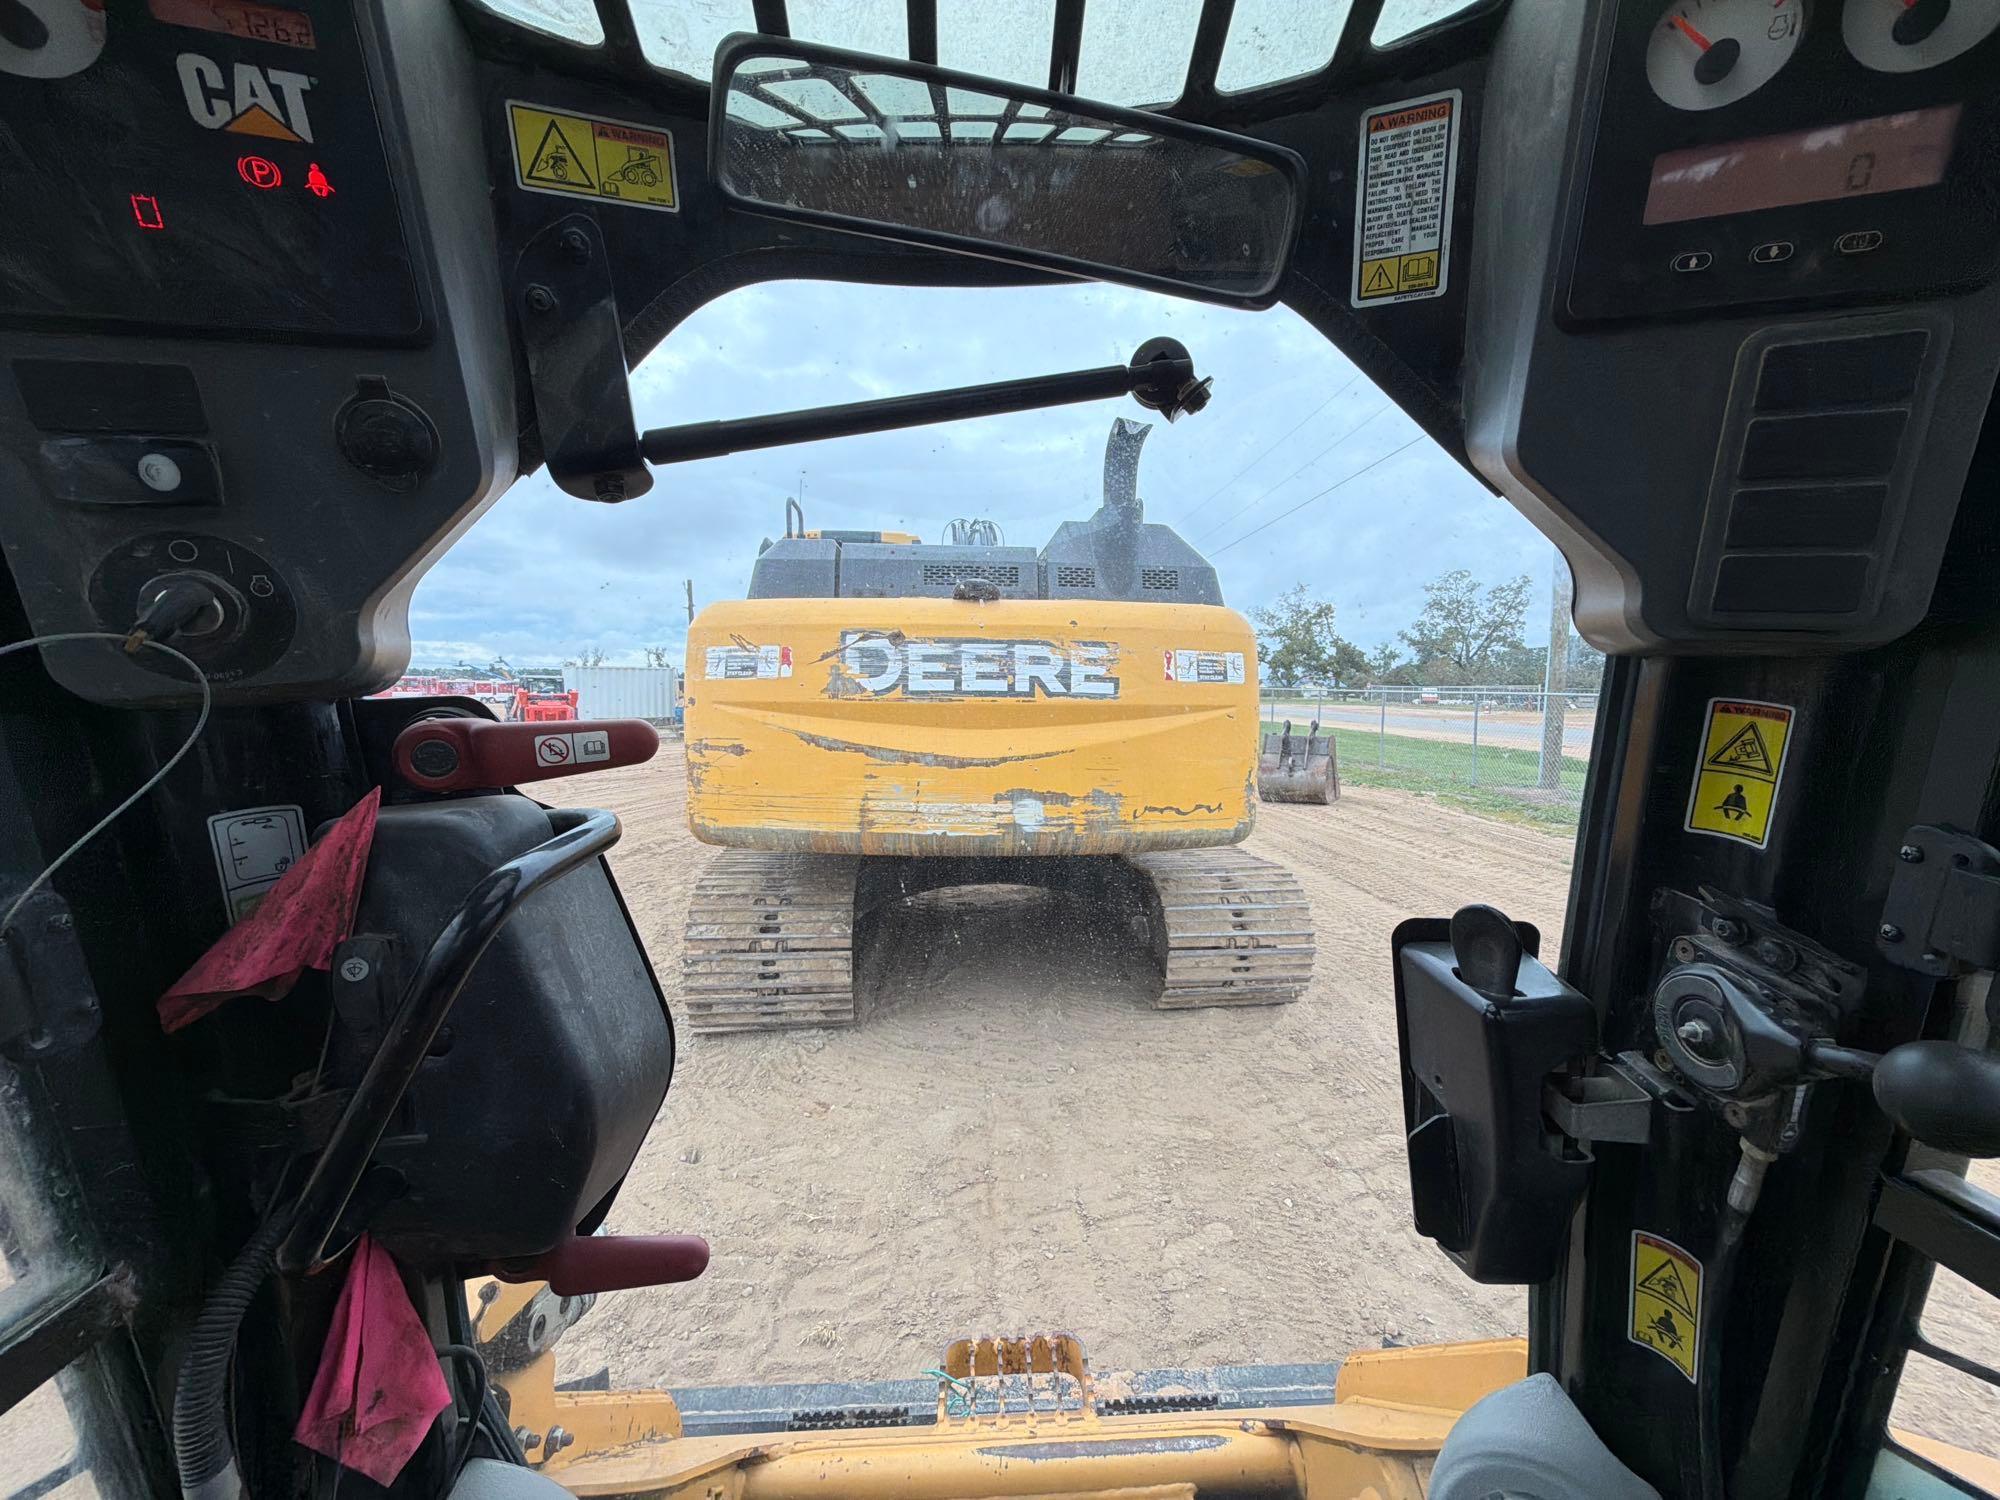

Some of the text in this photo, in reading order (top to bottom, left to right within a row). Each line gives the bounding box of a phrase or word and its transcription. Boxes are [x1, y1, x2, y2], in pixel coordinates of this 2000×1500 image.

[176, 53, 313, 143] CAT
[1388, 105, 1447, 128] WARNING
[613, 131, 666, 147] WARNING
[1371, 138, 1379, 146] DO
[1380, 136, 1389, 144] NOT
[1421, 125, 1436, 135] WORK
[1438, 123, 1446, 131] ON
[1371, 133, 1445, 154] THIS EQUIPMENT UNLESS YOU
[1370, 142, 1444, 163] HAVE READ AND UNDERSTAND
[1387, 154, 1424, 168] INSTRUCTIONS
[1432, 151, 1444, 159] AND
[1369, 171, 1394, 180] WARNINGS
[1415, 160, 1443, 171] OPERATION
[1368, 188, 1388, 198] FAILURE
[1405, 181, 1426, 192] FOLLOW
[1431, 178, 1441, 186] THE
[1380, 174, 1414, 187] MAINTENANCE
[1367, 204, 1392, 215] WARNINGS
[1394, 201, 1411, 210] COULD
[1413, 197, 1432, 207] RESULT
[1368, 194, 1402, 206] INSTRUCTIONS
[1366, 213, 1438, 232] ANY CATERPILLAR DEALER FOR
[1367, 215, 1384, 223] INJURY
[1417, 204, 1439, 214] CONTACT
[1365, 239, 1384, 249] PROPER
[1391, 236, 1404, 245] CARE
[1423, 230, 1438, 239] YOUR
[1366, 228, 1401, 240] REPLACEMENT
[843, 632, 1117, 695] DEERE
